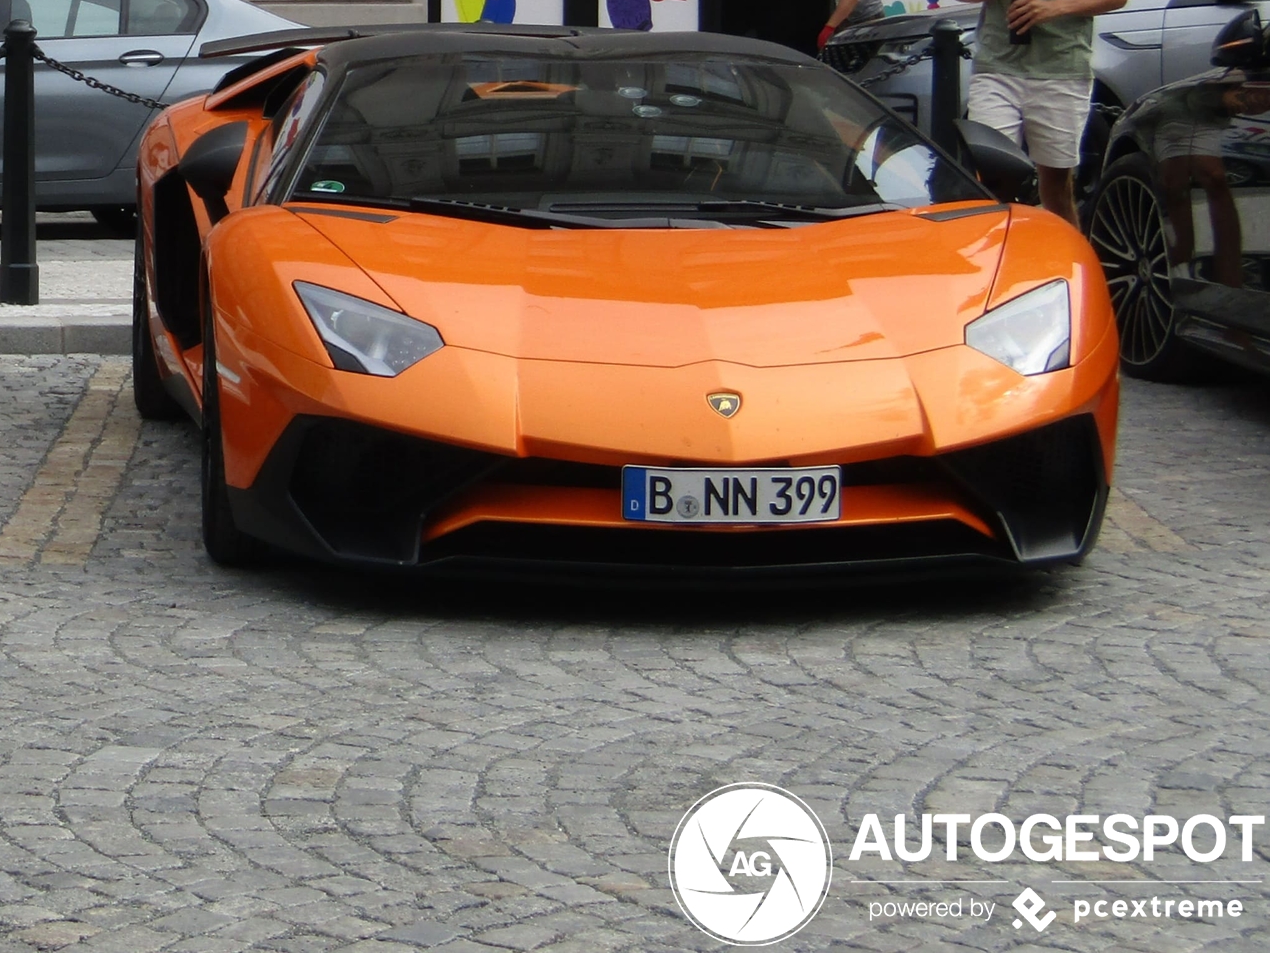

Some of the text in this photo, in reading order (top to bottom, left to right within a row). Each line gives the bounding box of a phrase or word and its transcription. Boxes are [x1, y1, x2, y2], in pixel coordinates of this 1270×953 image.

[630, 499, 639, 511] D
[649, 475, 837, 516] B NN 399
